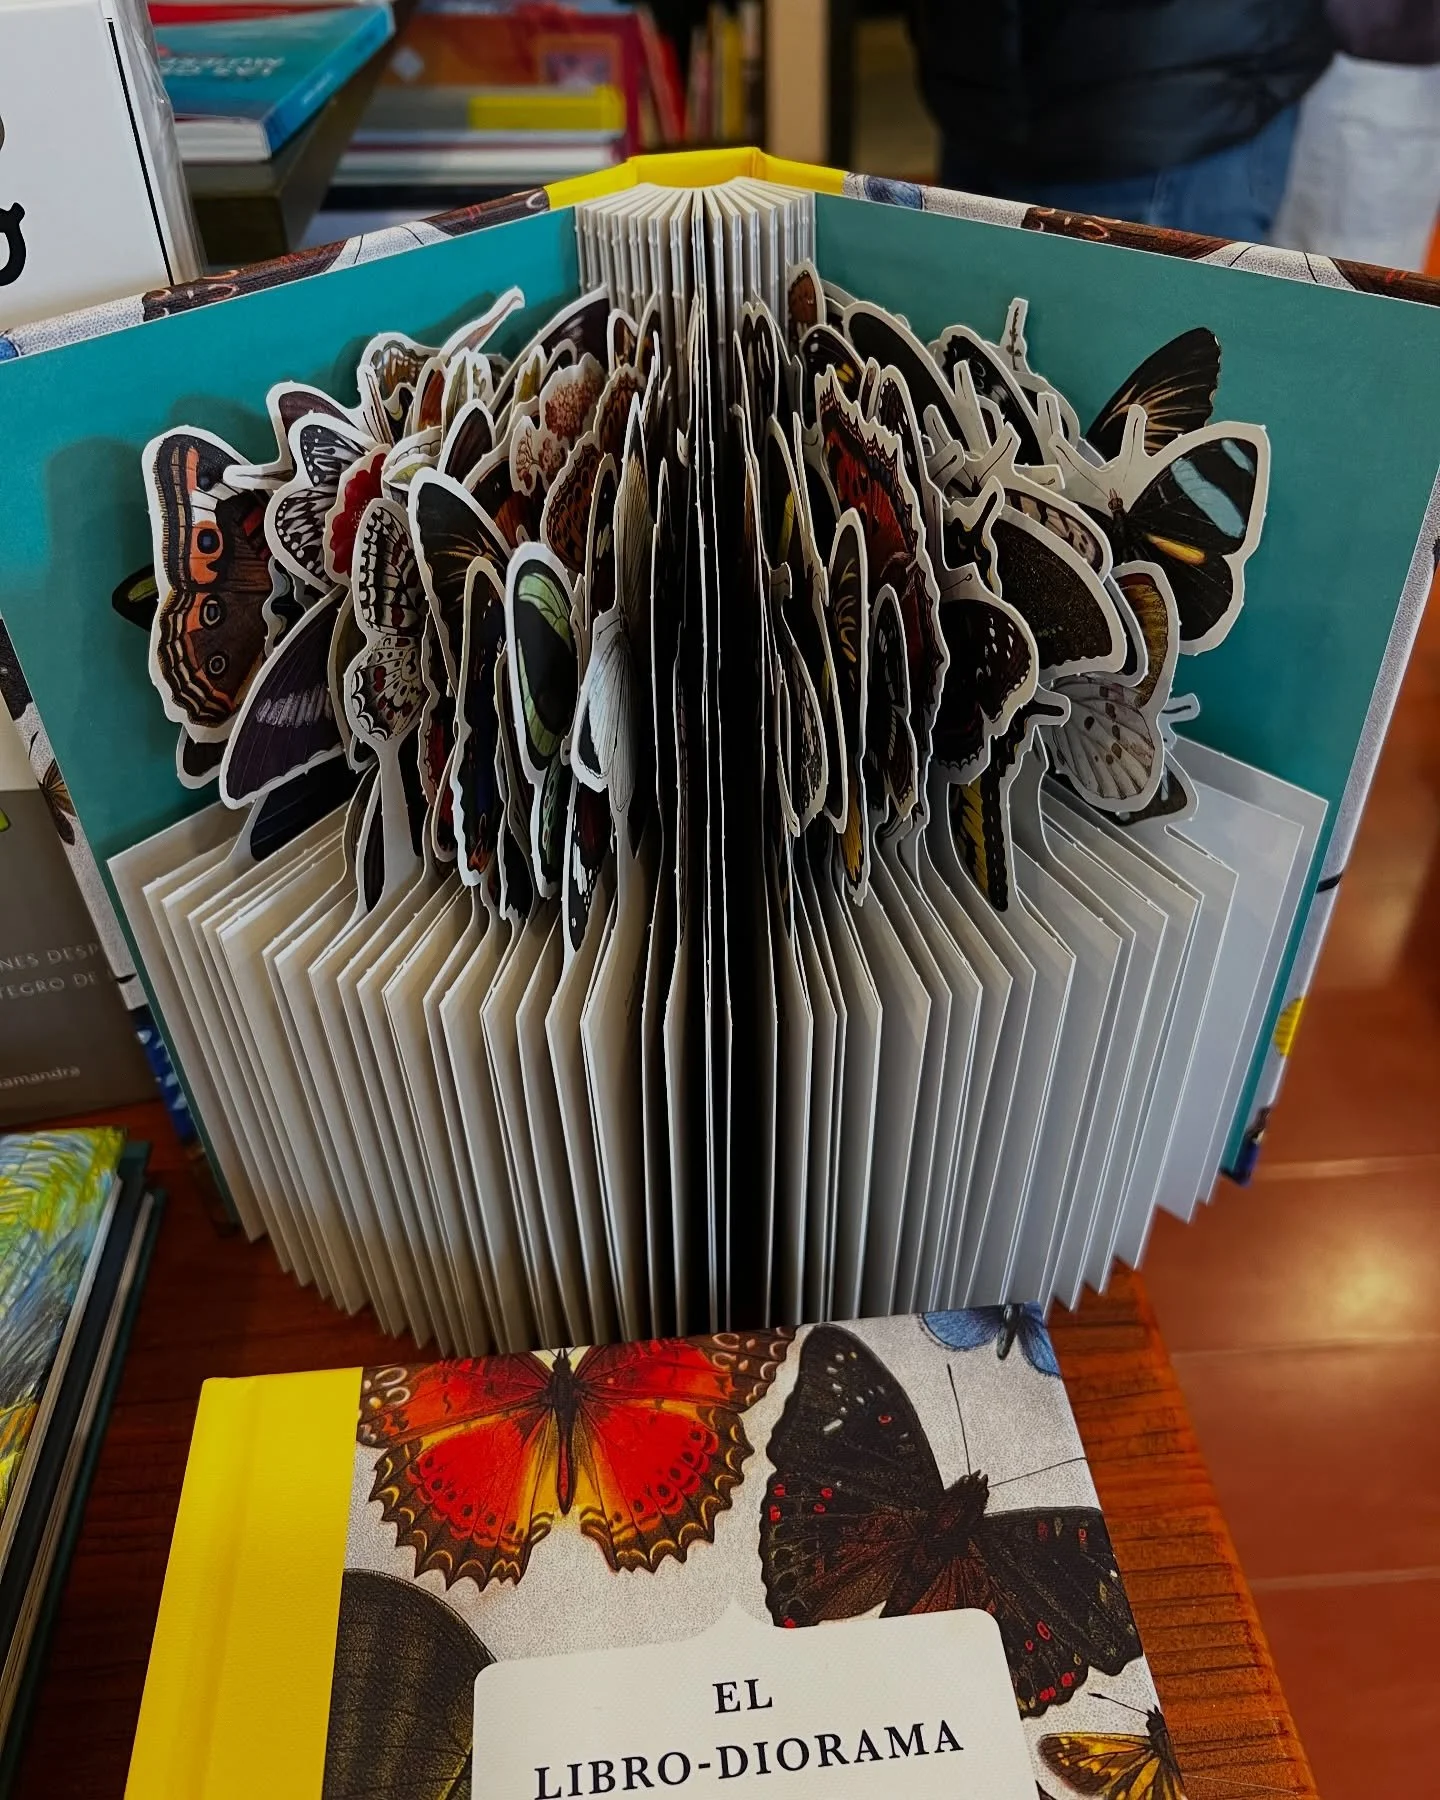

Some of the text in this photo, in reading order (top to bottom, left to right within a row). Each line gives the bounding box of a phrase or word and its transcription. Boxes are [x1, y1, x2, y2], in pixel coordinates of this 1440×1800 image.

[0, 1065, 80, 1089] amandra
[712, 1678, 773, 1714] EL
[534, 1719, 964, 1800] LIBRO-DIORAMA
